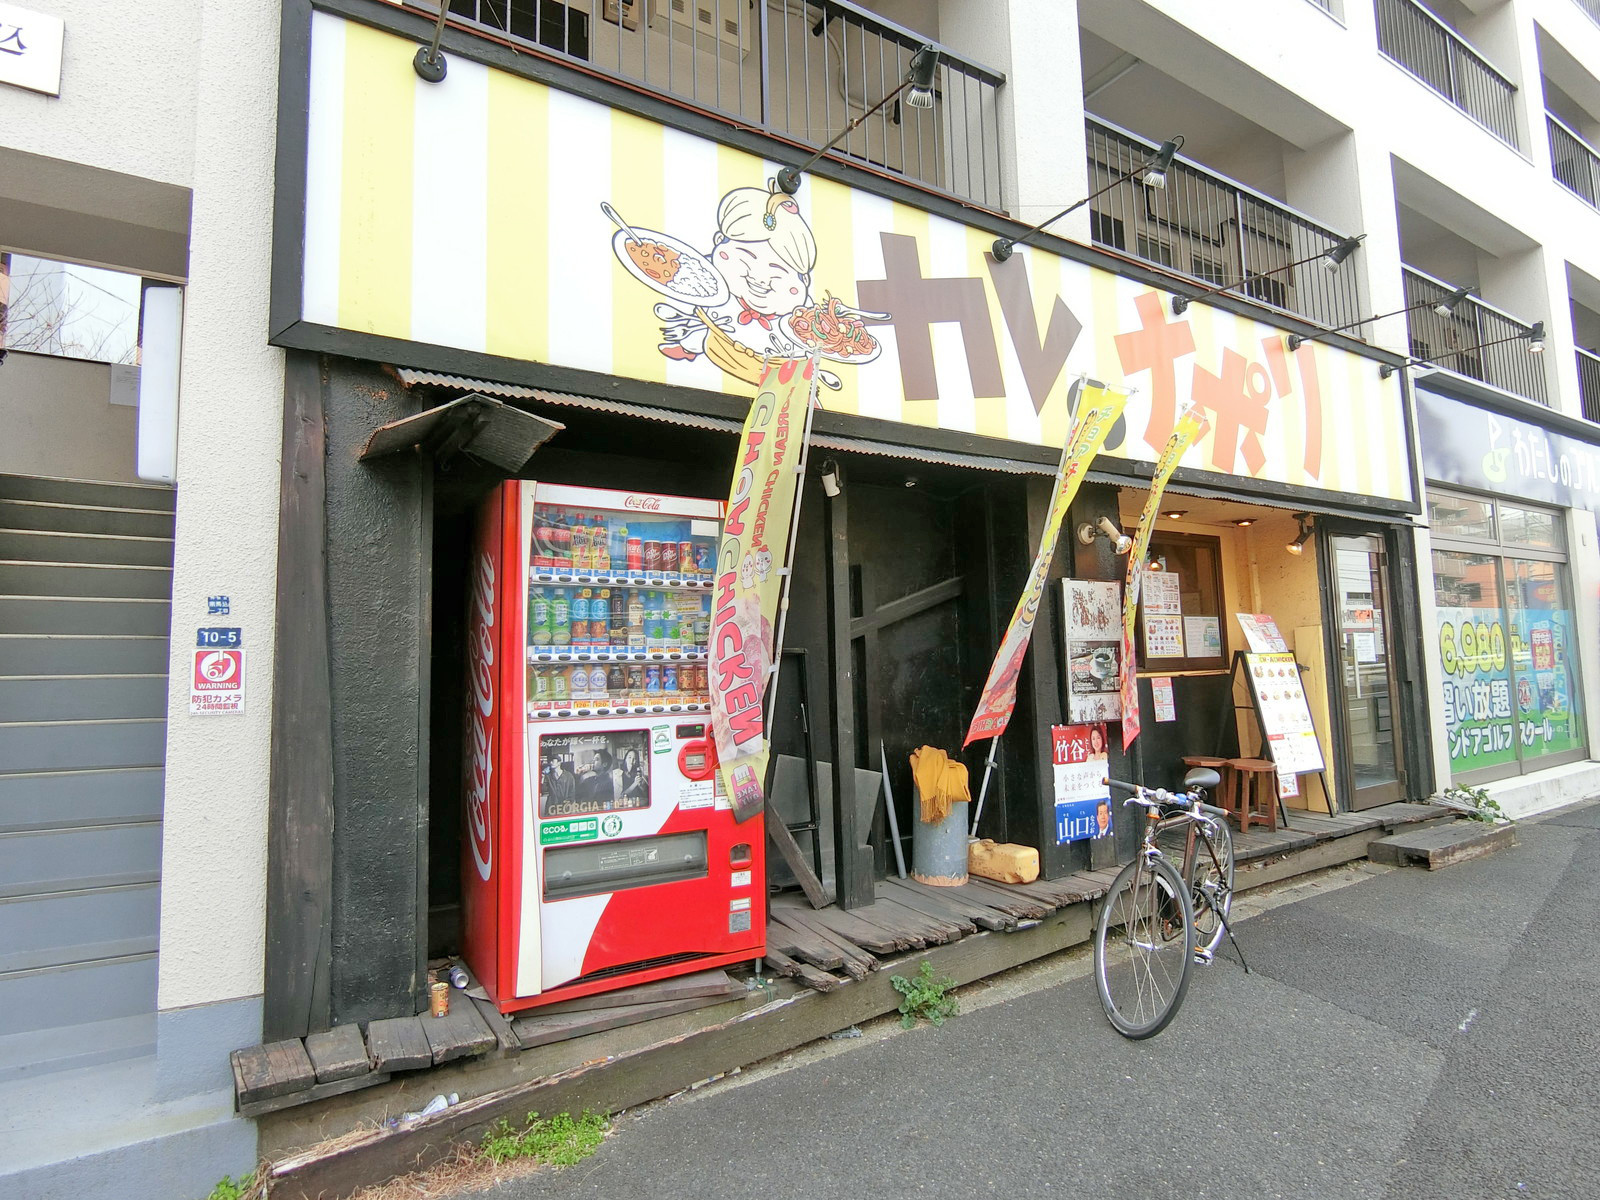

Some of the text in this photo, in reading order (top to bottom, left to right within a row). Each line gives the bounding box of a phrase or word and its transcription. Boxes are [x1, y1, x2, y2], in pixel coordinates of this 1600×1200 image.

[624, 495, 661, 510] Coca-Cola
[203, 631, 237, 642] 10-5
[192, 694, 242, 704] 防犯カメラ
[467, 551, 495, 881] Coca-Cola
[1056, 739, 1085, 762] 竹谷
[548, 801, 599, 815] GEORGIA
[1059, 816, 1089, 840] 山口
